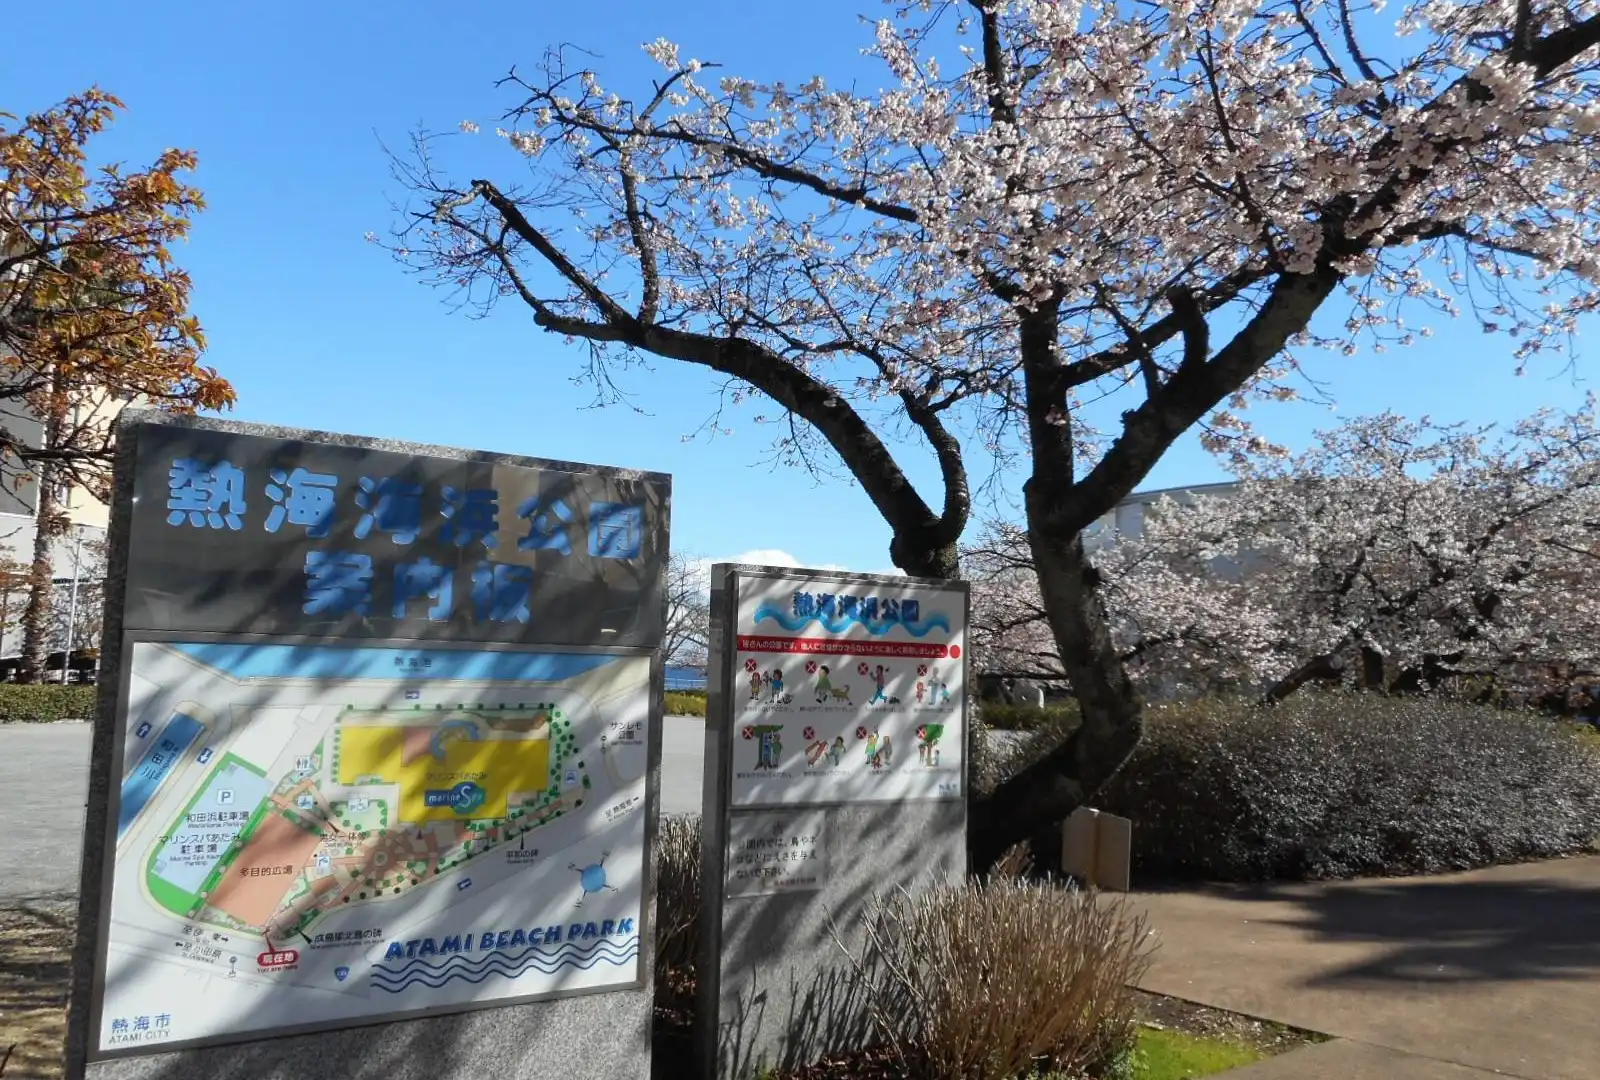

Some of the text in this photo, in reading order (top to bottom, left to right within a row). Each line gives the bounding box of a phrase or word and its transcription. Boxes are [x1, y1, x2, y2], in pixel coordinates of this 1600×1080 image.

[167, 457, 643, 558] 熱海海浜公園
[303, 550, 532, 623] 案内板
[793, 590, 919, 623] 熱海海浜公園
[608, 720, 643, 731] サンレモ
[221, 791, 231, 803] P
[187, 811, 249, 823] 和田浜駐車場
[160, 832, 240, 845] マリンスパあたみ
[180, 844, 217, 854] 駐車場
[239, 865, 293, 877] 多目的広場
[384, 933, 474, 961] ATAMI
[480, 925, 562, 950] BEACH
[567, 918, 634, 941] PARK
[263, 951, 295, 964] 現在地
[111, 1013, 171, 1034] 熱海市
[109, 1029, 170, 1044] ATAMI CITY
